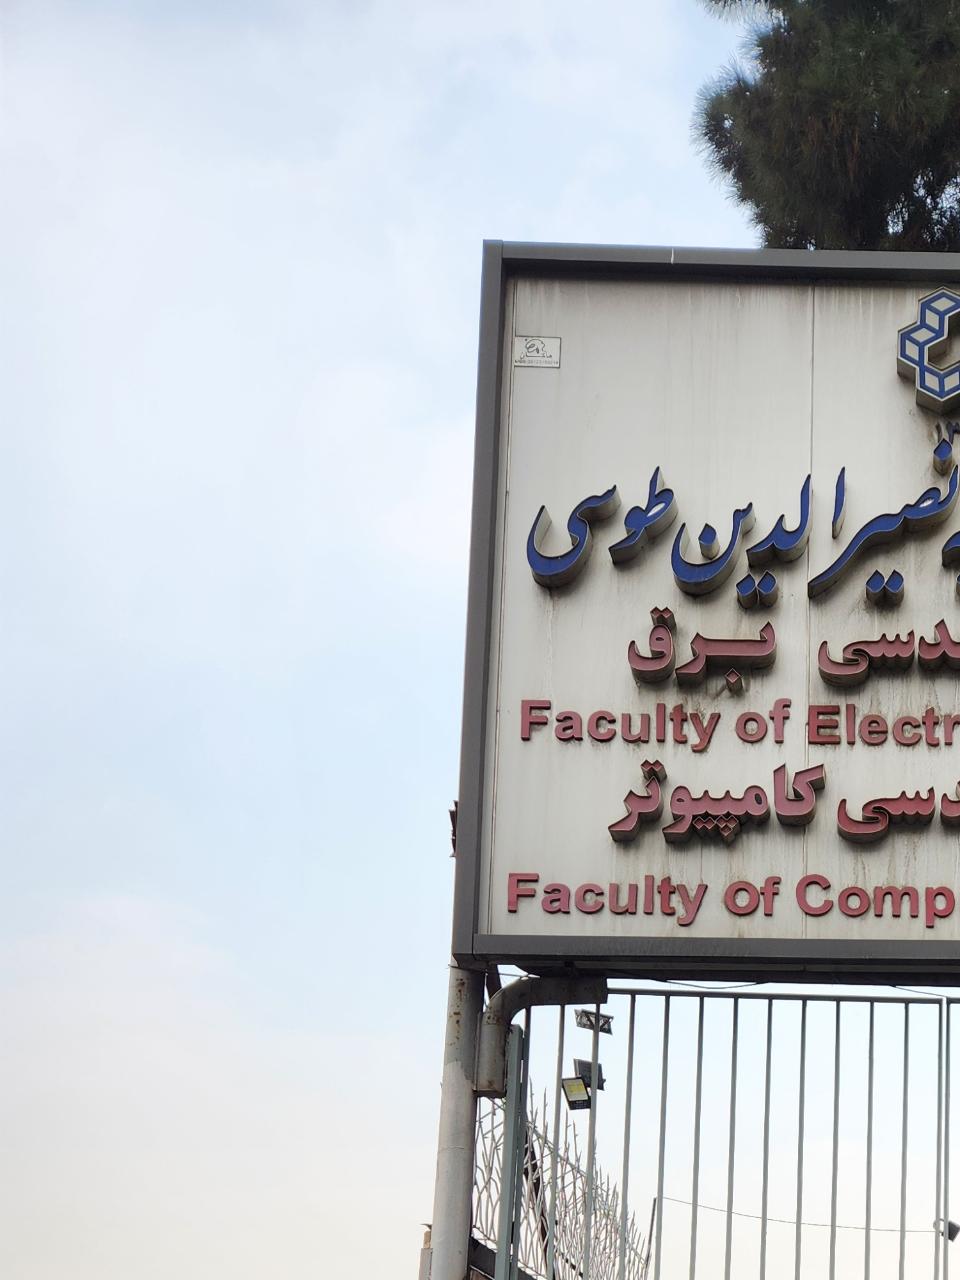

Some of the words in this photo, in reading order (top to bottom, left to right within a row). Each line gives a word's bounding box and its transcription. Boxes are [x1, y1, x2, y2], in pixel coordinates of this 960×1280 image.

[525, 465, 678, 588] طوسی
[627, 606, 777, 694] برق
[519, 698, 721, 753] Faculty
[735, 697, 792, 744] of
[607, 758, 827, 844] کامپیوتر
[506, 872, 708, 927] Faculty
[723, 875, 782, 917] of
